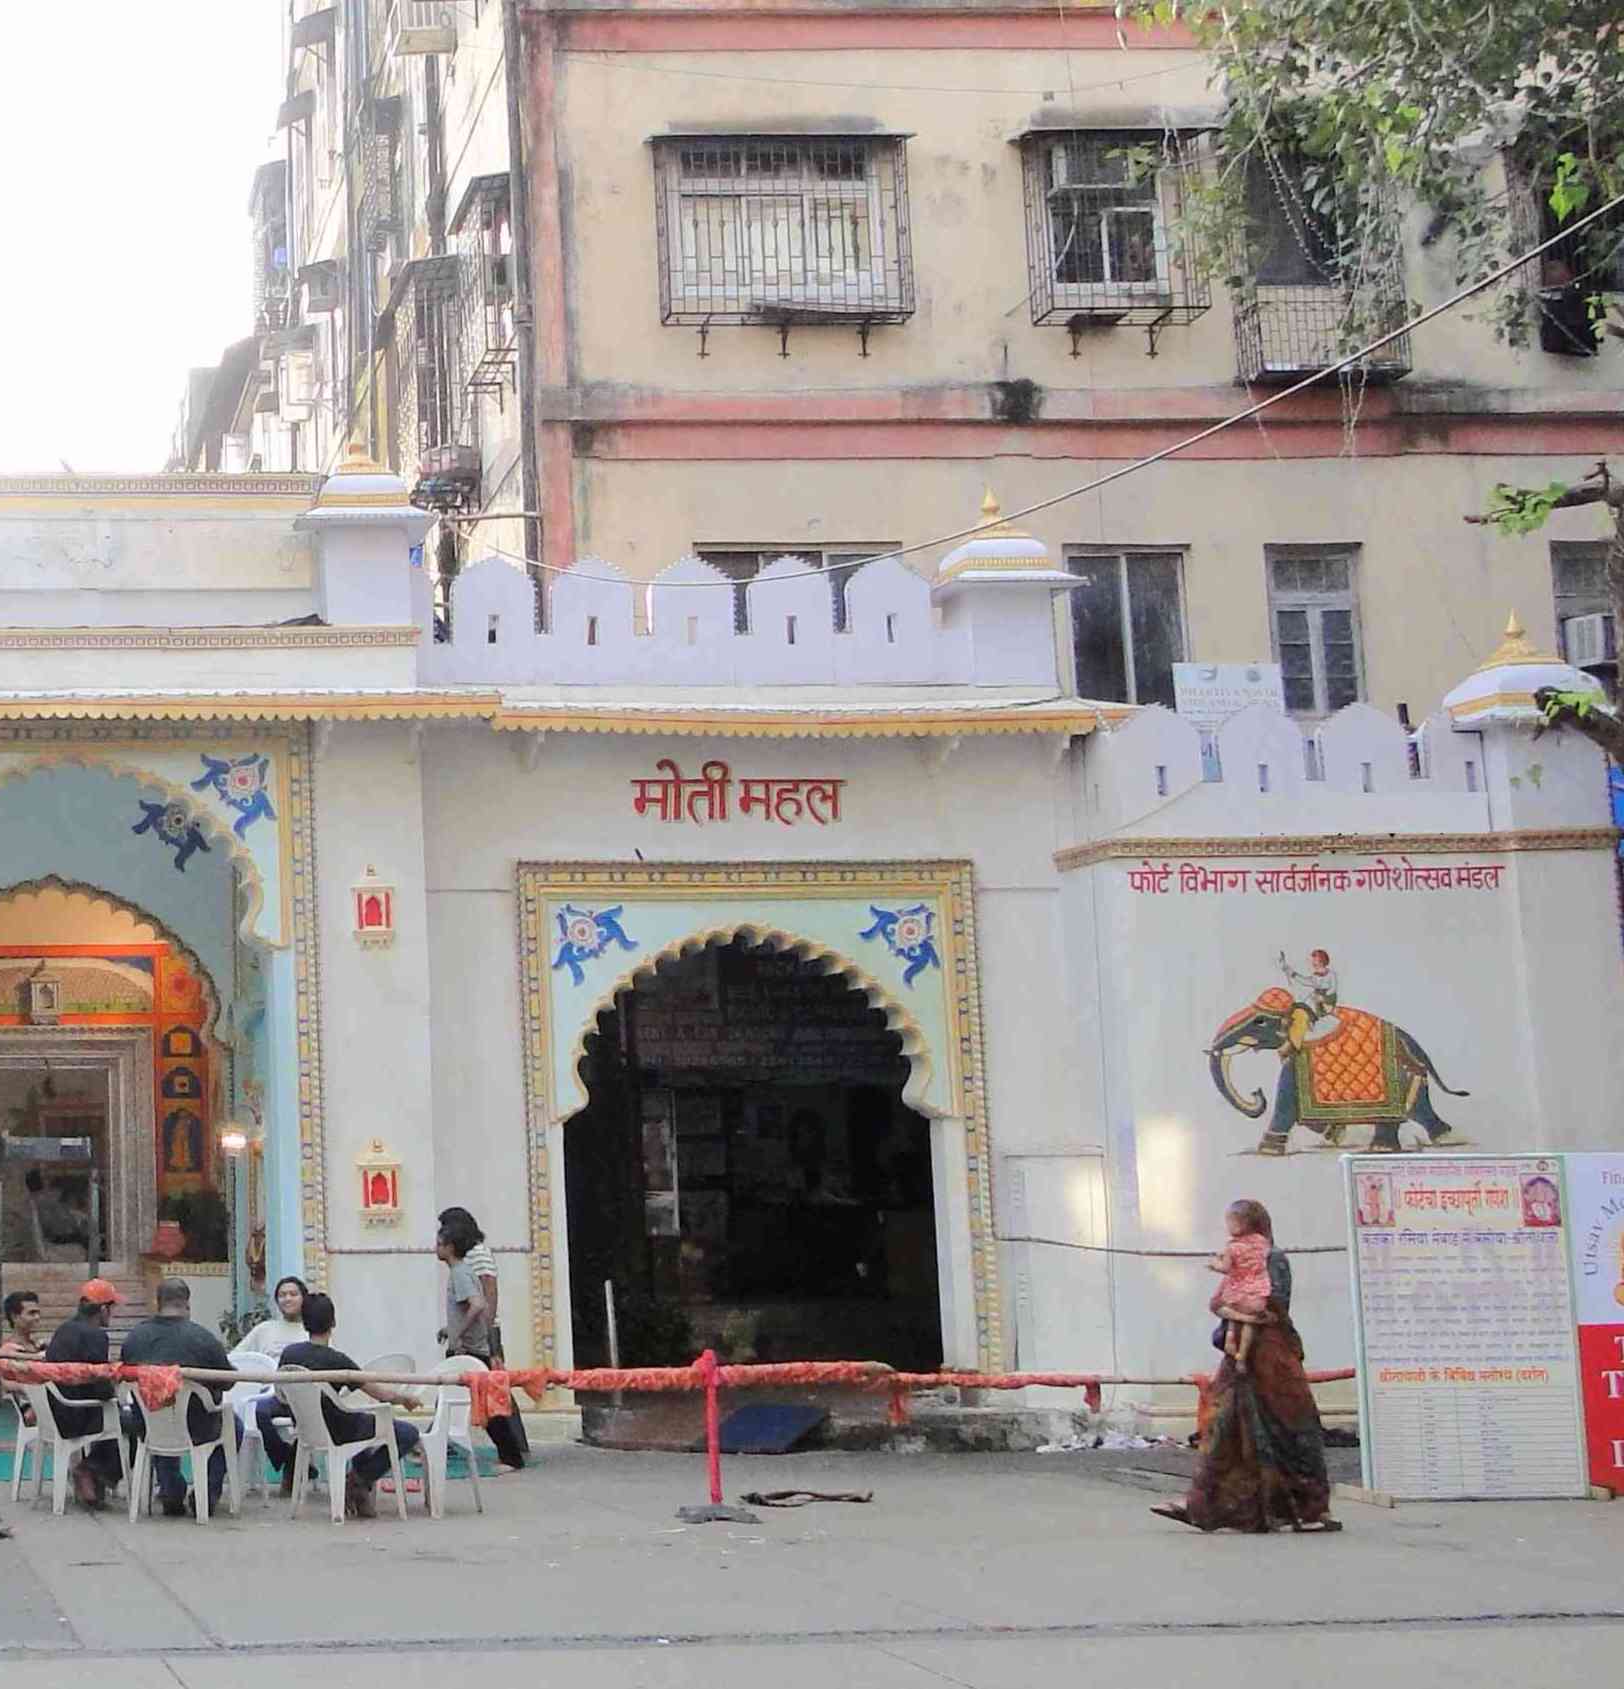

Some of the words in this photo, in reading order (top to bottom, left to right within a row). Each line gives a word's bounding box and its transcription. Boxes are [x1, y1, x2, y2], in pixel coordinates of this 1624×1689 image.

[630, 758, 732, 825] मोती
[738, 778, 847, 826] महल
[1127, 860, 1173, 895] फोर्ट
[1178, 862, 1251, 894] विभाग
[1352, 857, 1454, 892] गणेशोत्सव
[1453, 861, 1506, 891] मंडल
